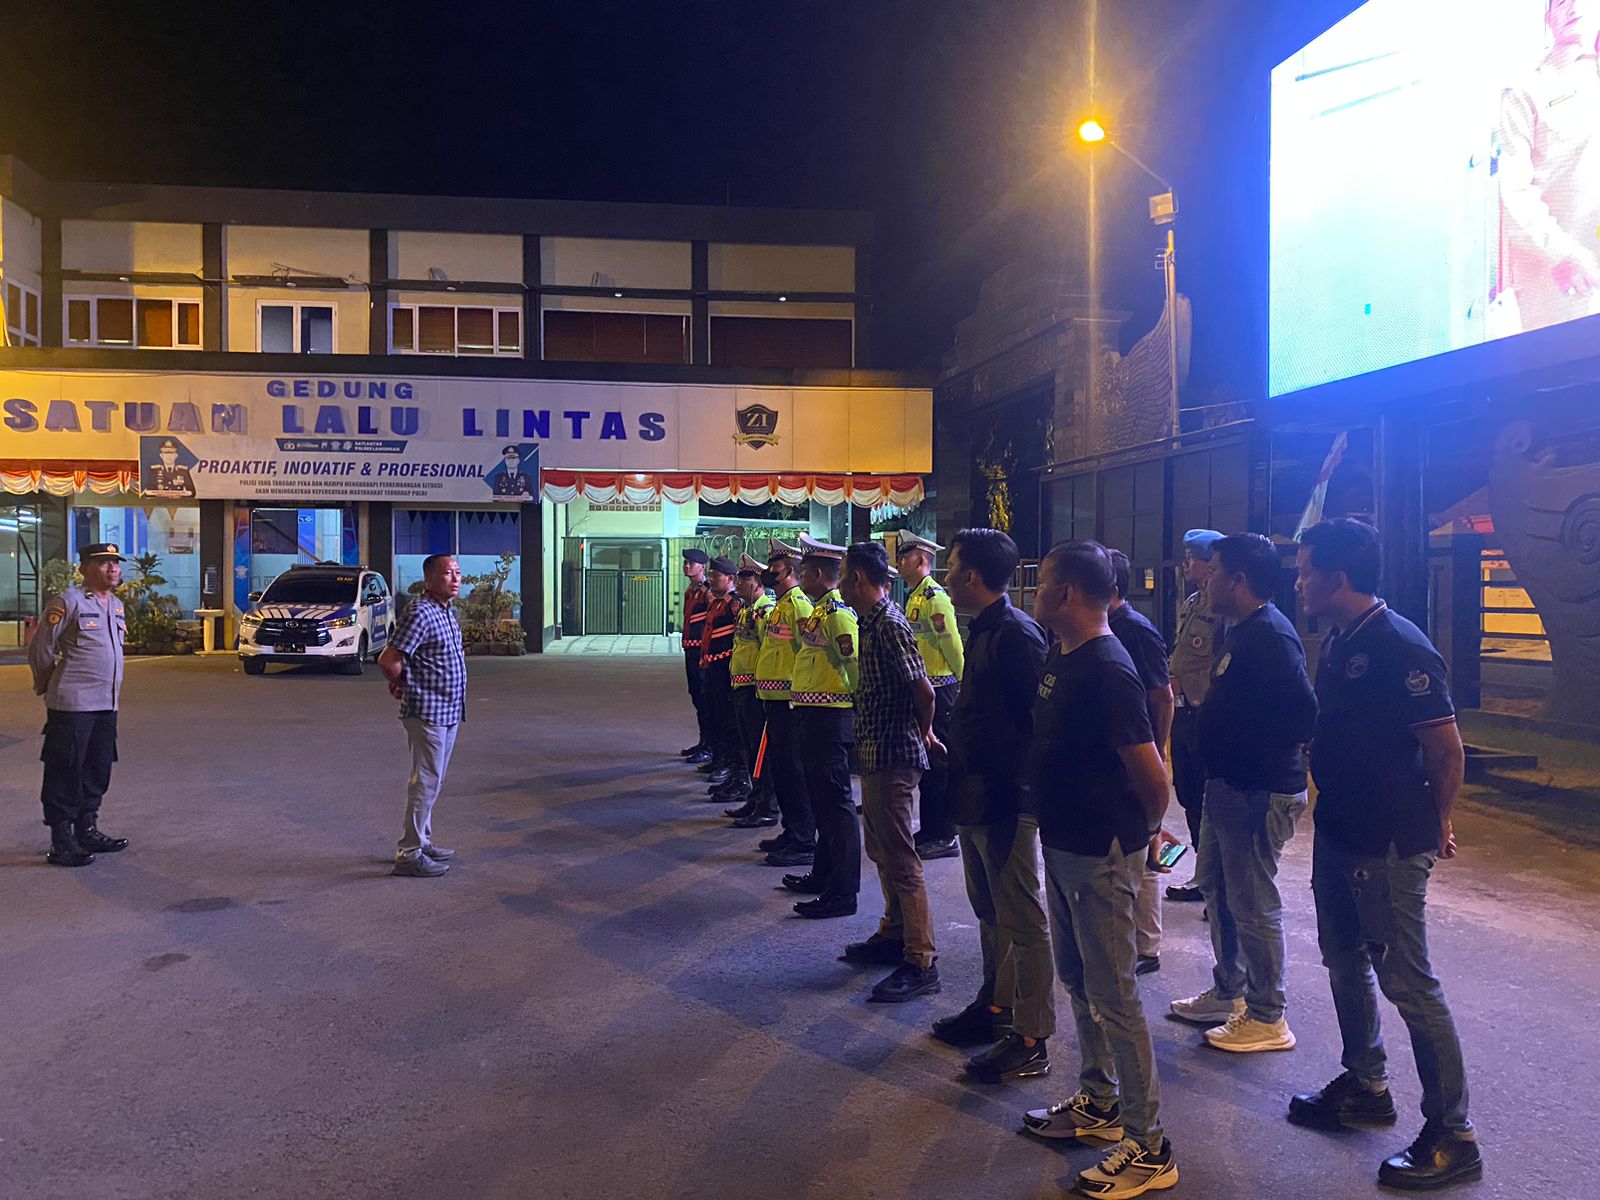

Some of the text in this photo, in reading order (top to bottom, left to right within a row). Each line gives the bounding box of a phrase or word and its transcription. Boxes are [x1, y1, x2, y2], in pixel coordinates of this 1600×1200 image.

[266, 380, 413, 399] GEDUNG
[3, 398, 666, 441] SATUAN LALU LINTAS
[746, 413, 768, 427] ZI
[197, 459, 485, 478] PROAKTIF, INOVATIF & PROFESIONAL
